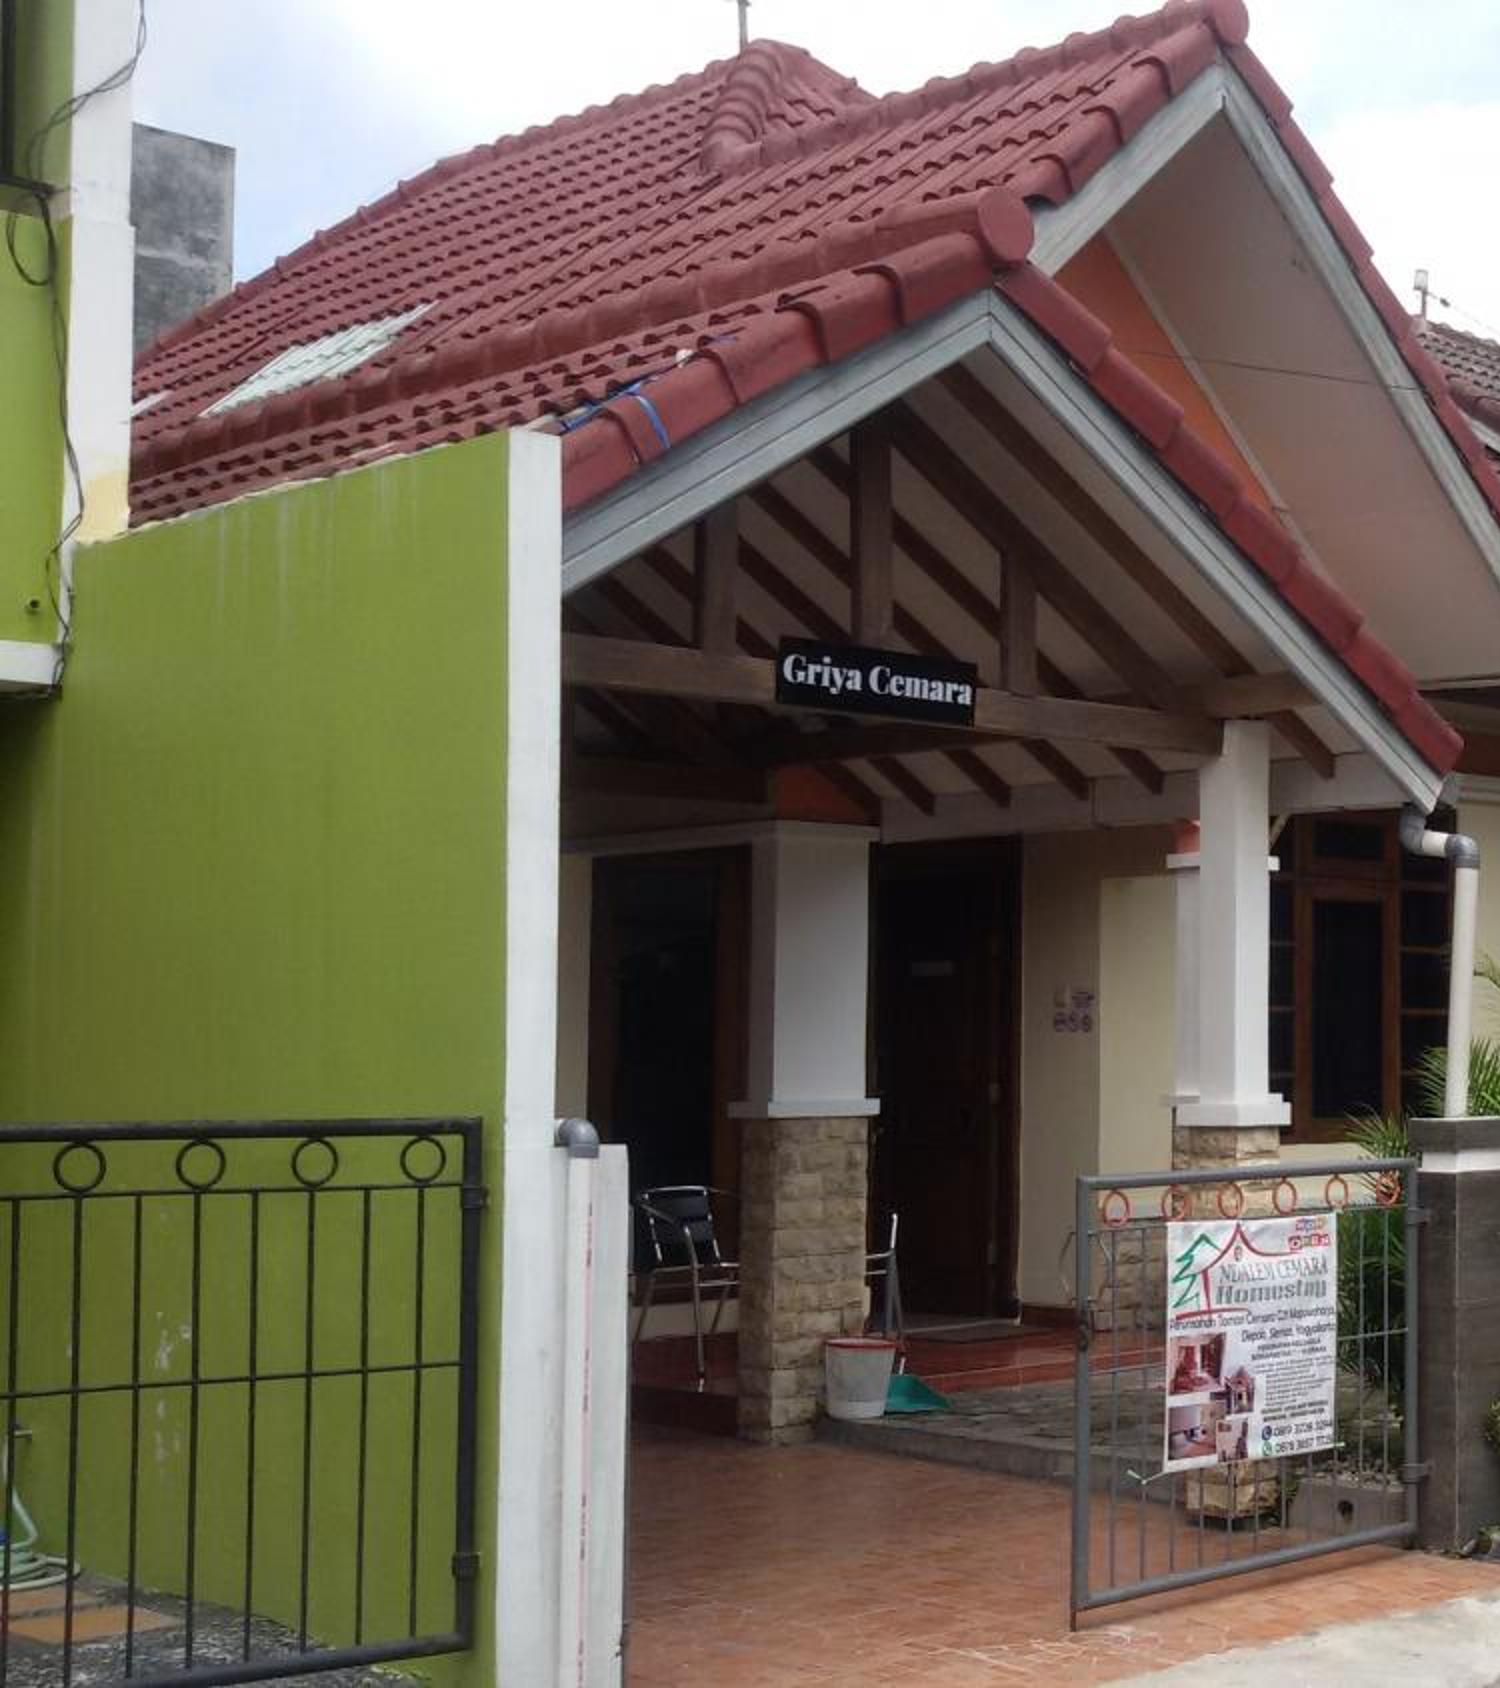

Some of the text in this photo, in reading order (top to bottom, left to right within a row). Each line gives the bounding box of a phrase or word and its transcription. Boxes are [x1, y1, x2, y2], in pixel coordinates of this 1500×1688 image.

[783, 653, 972, 705] Griya Cemara
[1216, 1280, 1327, 1304] Homestay
